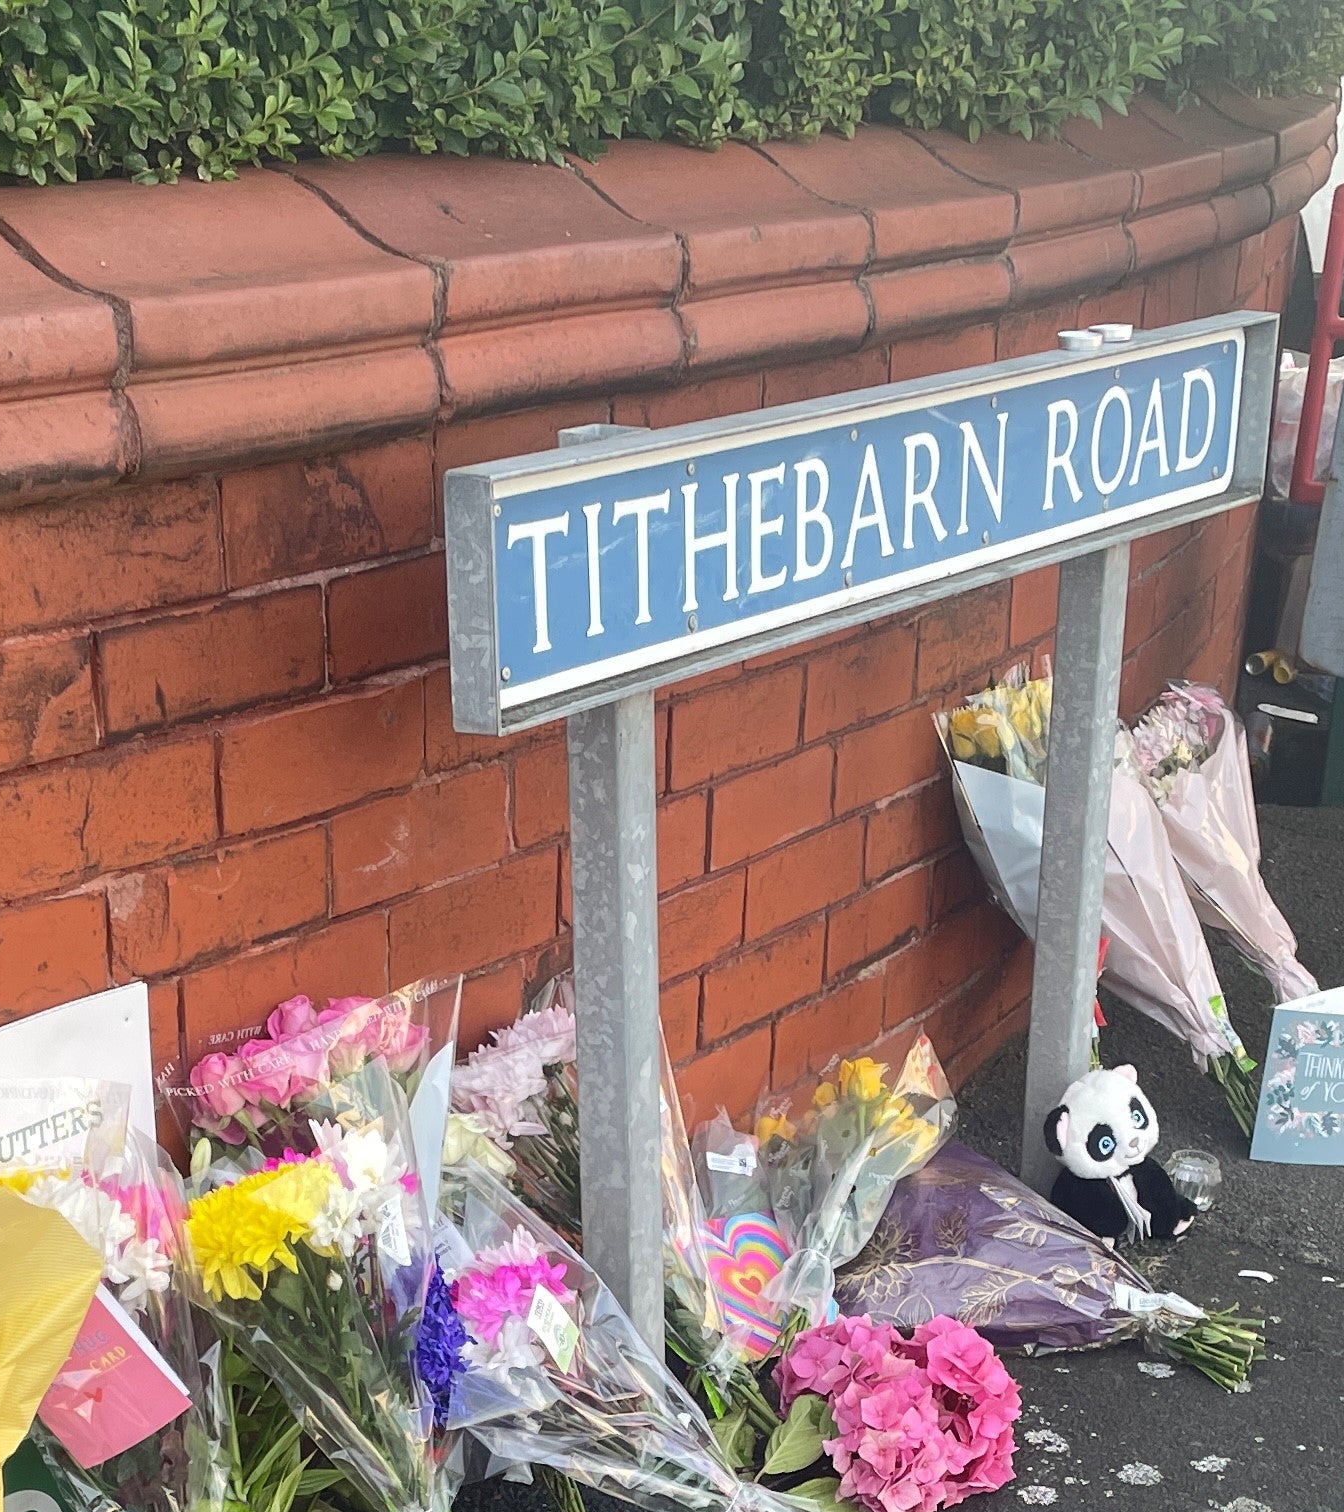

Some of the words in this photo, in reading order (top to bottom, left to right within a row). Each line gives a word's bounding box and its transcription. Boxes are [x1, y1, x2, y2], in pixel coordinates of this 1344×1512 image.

[506, 411, 1009, 655] TITHEBARN
[1041, 368, 1218, 512] ROAD
[165, 1083, 216, 1099] PICKED
[217, 1068, 255, 1091] WITH
[1299, 1081, 1321, 1102] of
[89, 1345, 127, 1372] CARD
